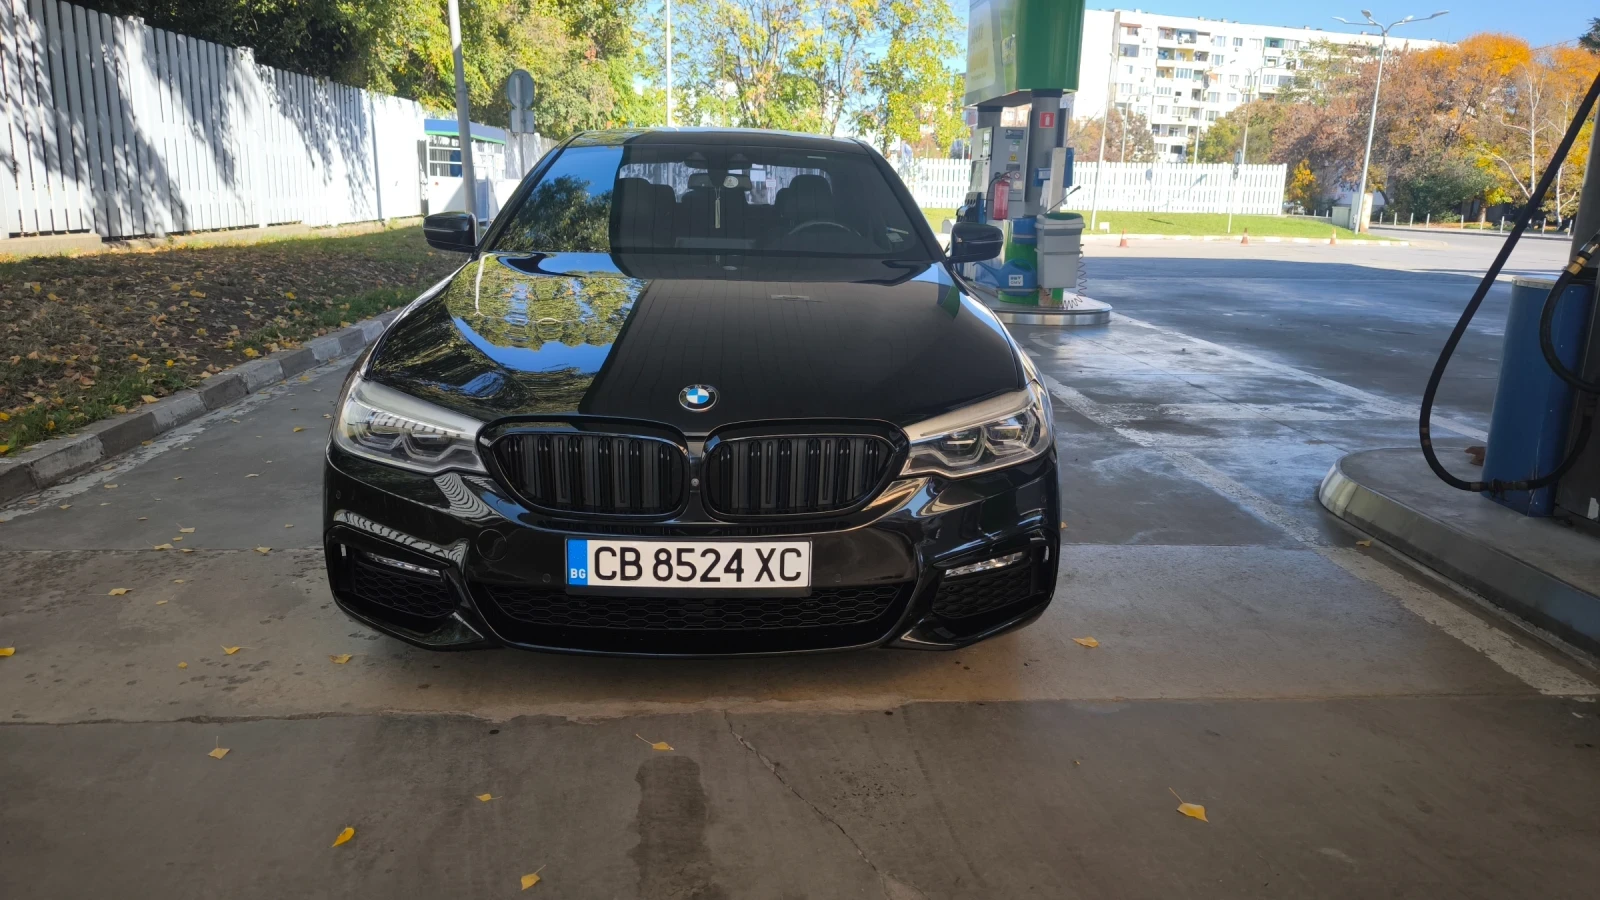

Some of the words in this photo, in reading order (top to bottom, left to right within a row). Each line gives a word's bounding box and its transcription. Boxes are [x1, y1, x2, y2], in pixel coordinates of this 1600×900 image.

[570, 568, 586, 579] BG
[594, 546, 643, 581] CB
[652, 547, 745, 582] 8524
[754, 547, 802, 582] XC
